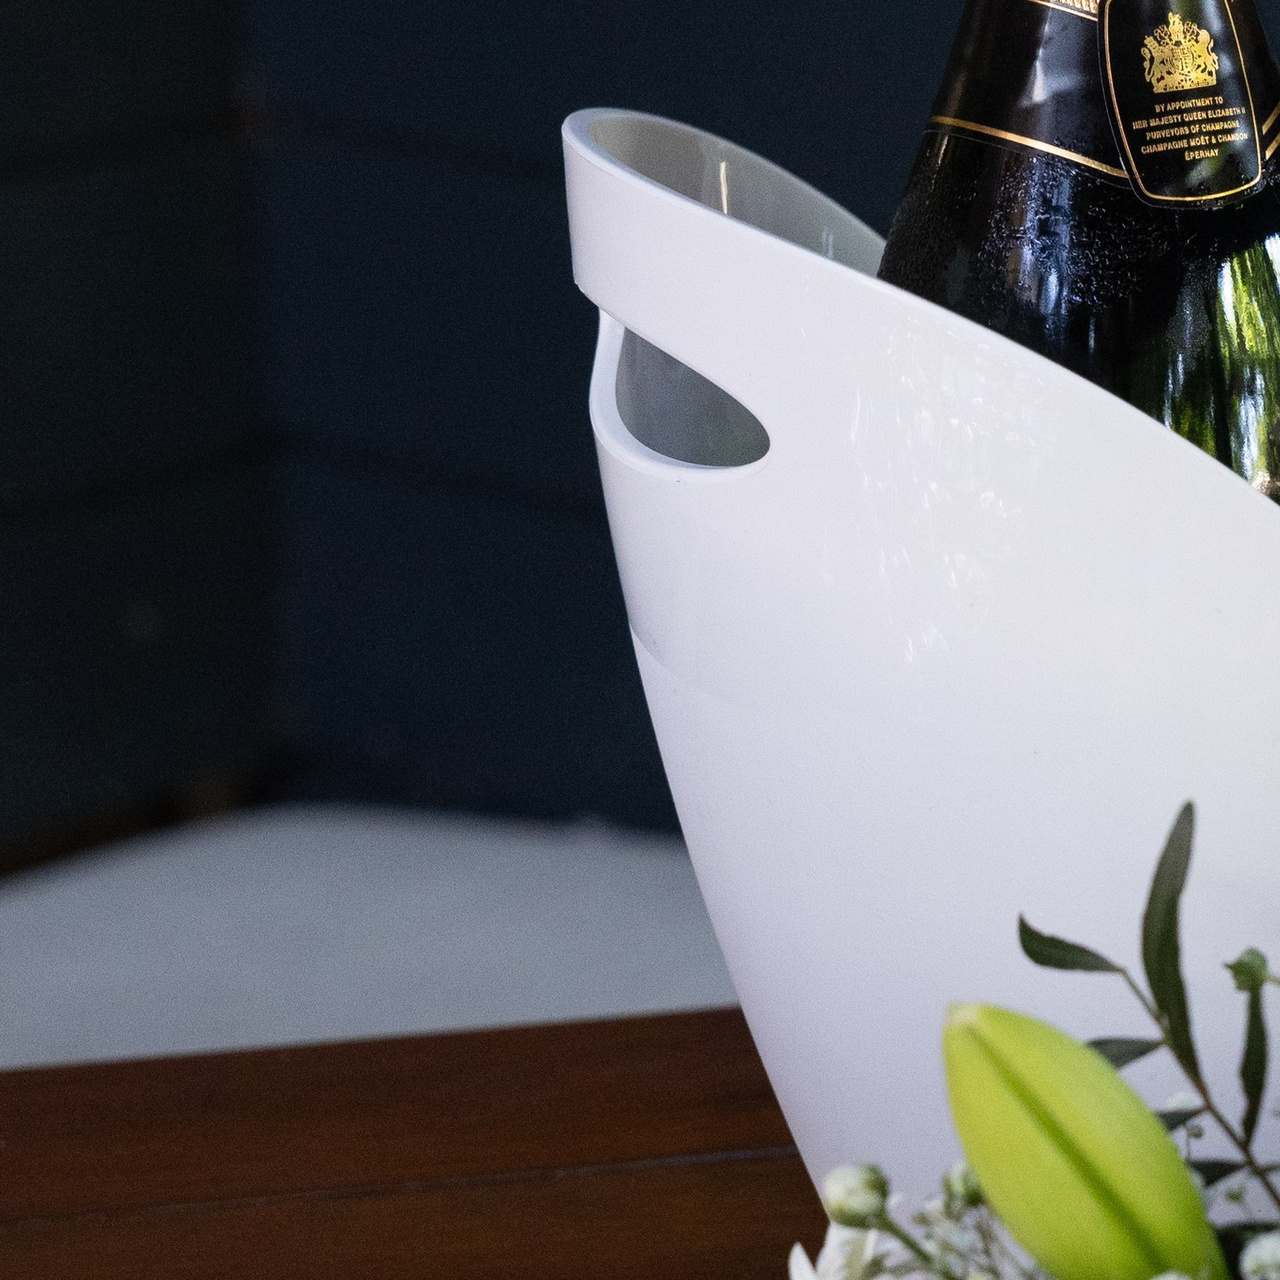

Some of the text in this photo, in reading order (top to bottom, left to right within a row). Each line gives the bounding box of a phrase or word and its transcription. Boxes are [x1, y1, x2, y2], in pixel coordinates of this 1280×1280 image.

[1155, 96, 1224, 113] BY APPOINTMENT TO
[1132, 120, 1148, 130] HER
[1150, 116, 1181, 126] MAJESTY
[1184, 111, 1206, 121] QUEEN
[1208, 107, 1241, 118] ELIZABETH
[1146, 120, 1240, 140] PURVEYORS OF CHAMPAGNE
[1141, 140, 1188, 155] CHAMPAGNE
[1218, 131, 1249, 143] CHANDON
[1185, 148, 1219, 161] ÉPERNAY
